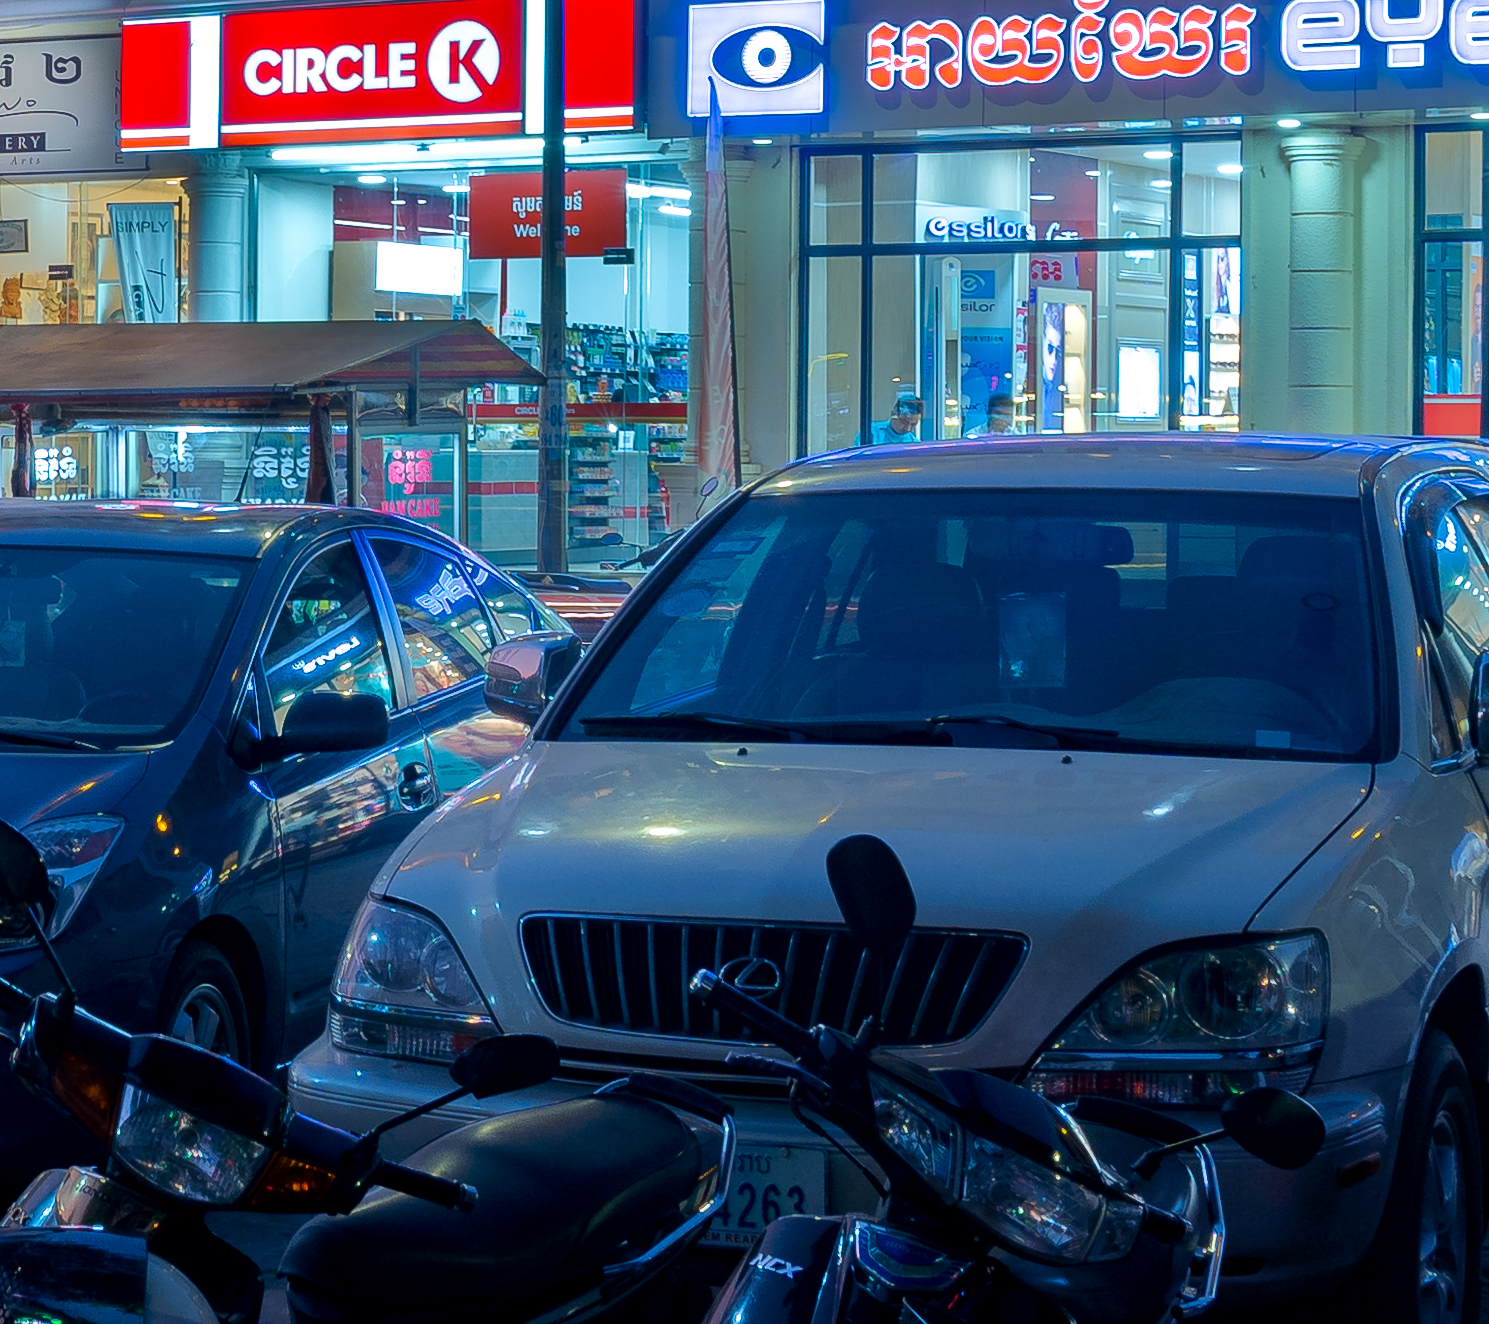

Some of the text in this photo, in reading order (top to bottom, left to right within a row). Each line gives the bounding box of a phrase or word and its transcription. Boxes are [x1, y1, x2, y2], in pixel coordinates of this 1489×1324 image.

[243, 31, 495, 102] CIRCLE K
[10, 155, 42, 166] Arts
[117, 221, 168, 233] SIMPLY
[408, 498, 440, 517] CAKE
[749, 1252, 803, 1278] NCX
